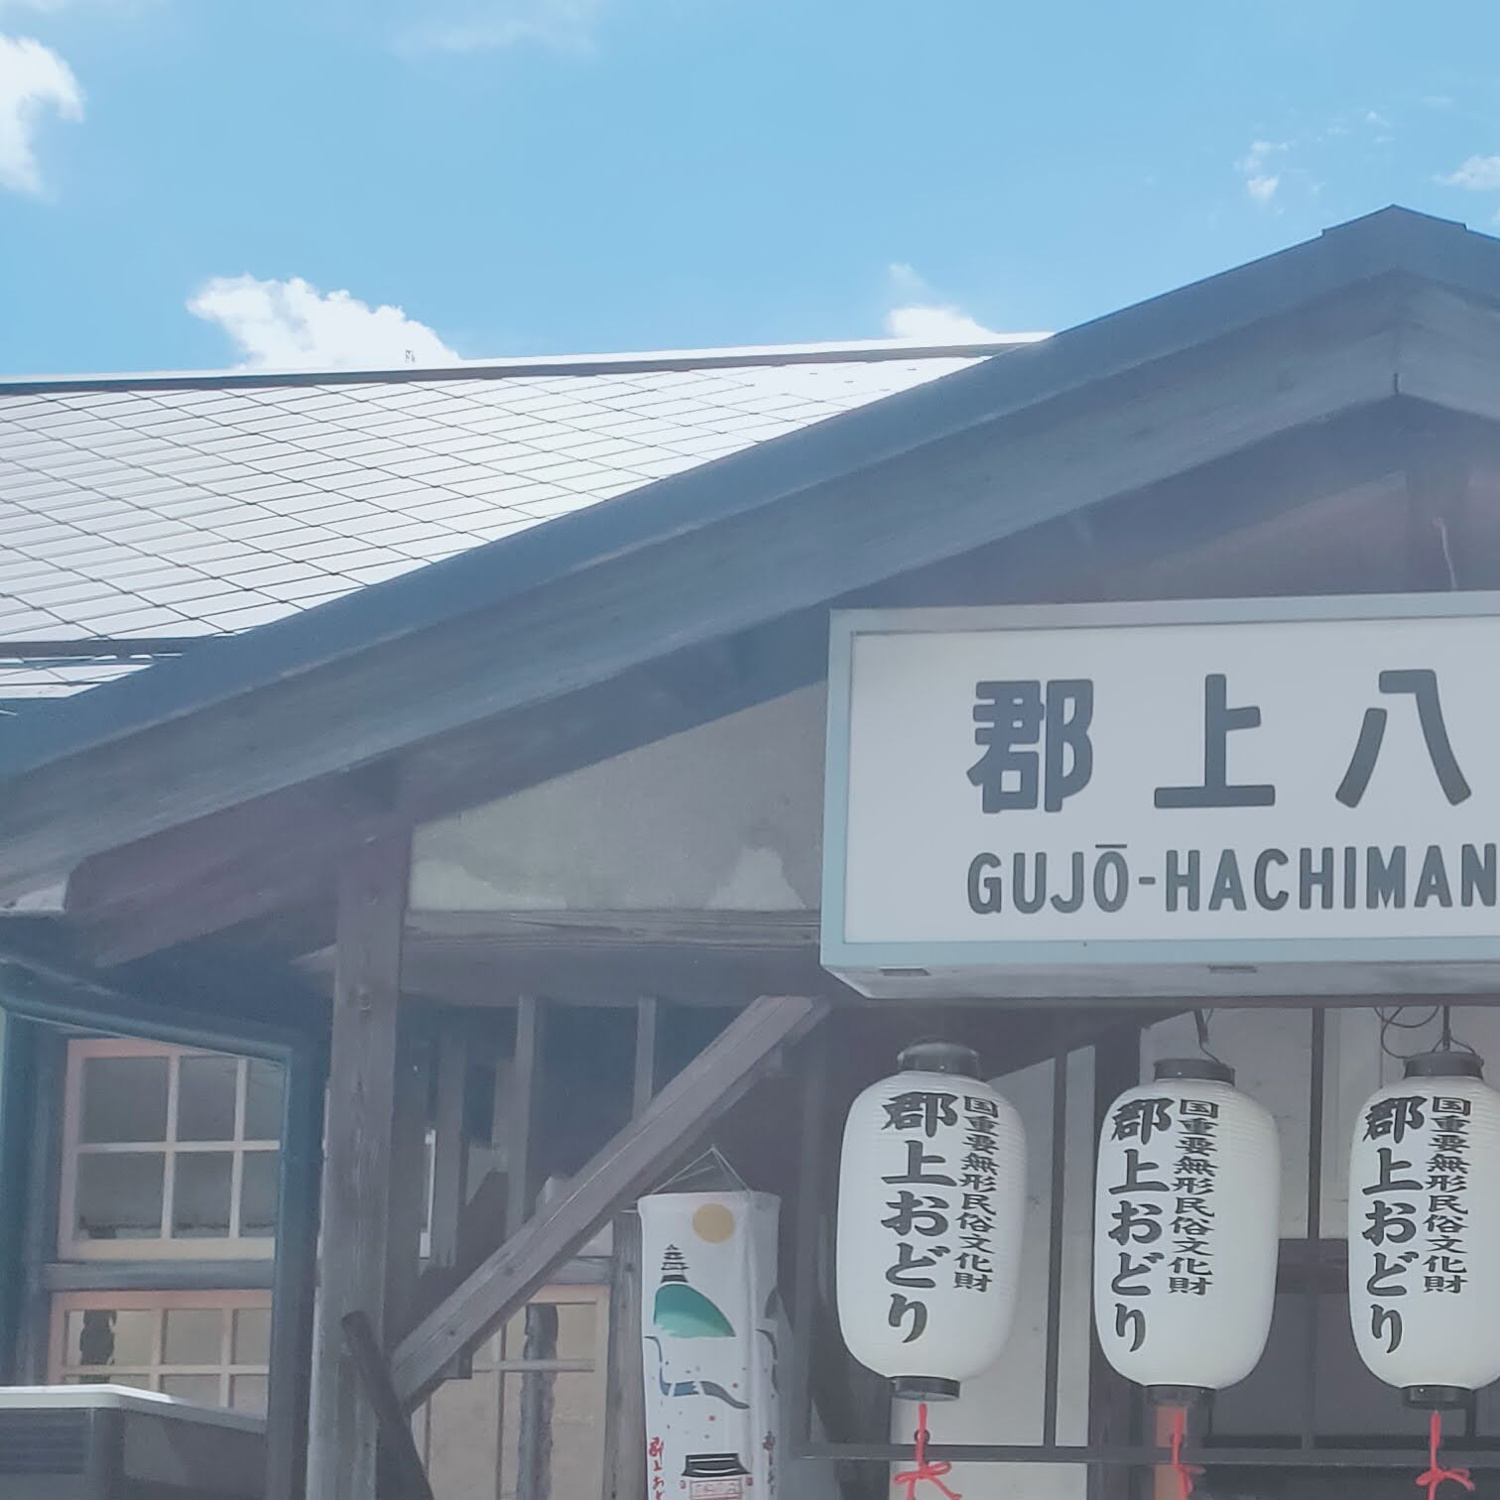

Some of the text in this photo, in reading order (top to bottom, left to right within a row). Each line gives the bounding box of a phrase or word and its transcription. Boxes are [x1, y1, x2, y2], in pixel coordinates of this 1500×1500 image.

[967, 842, 1499, 915] GUJŌ-HACHIMAN
[881, 1091, 958, 1344] 郡上おどり
[1107, 1098, 1174, 1353] 郡上おどり
[1361, 1095, 1428, 1354] 郡上おどり
